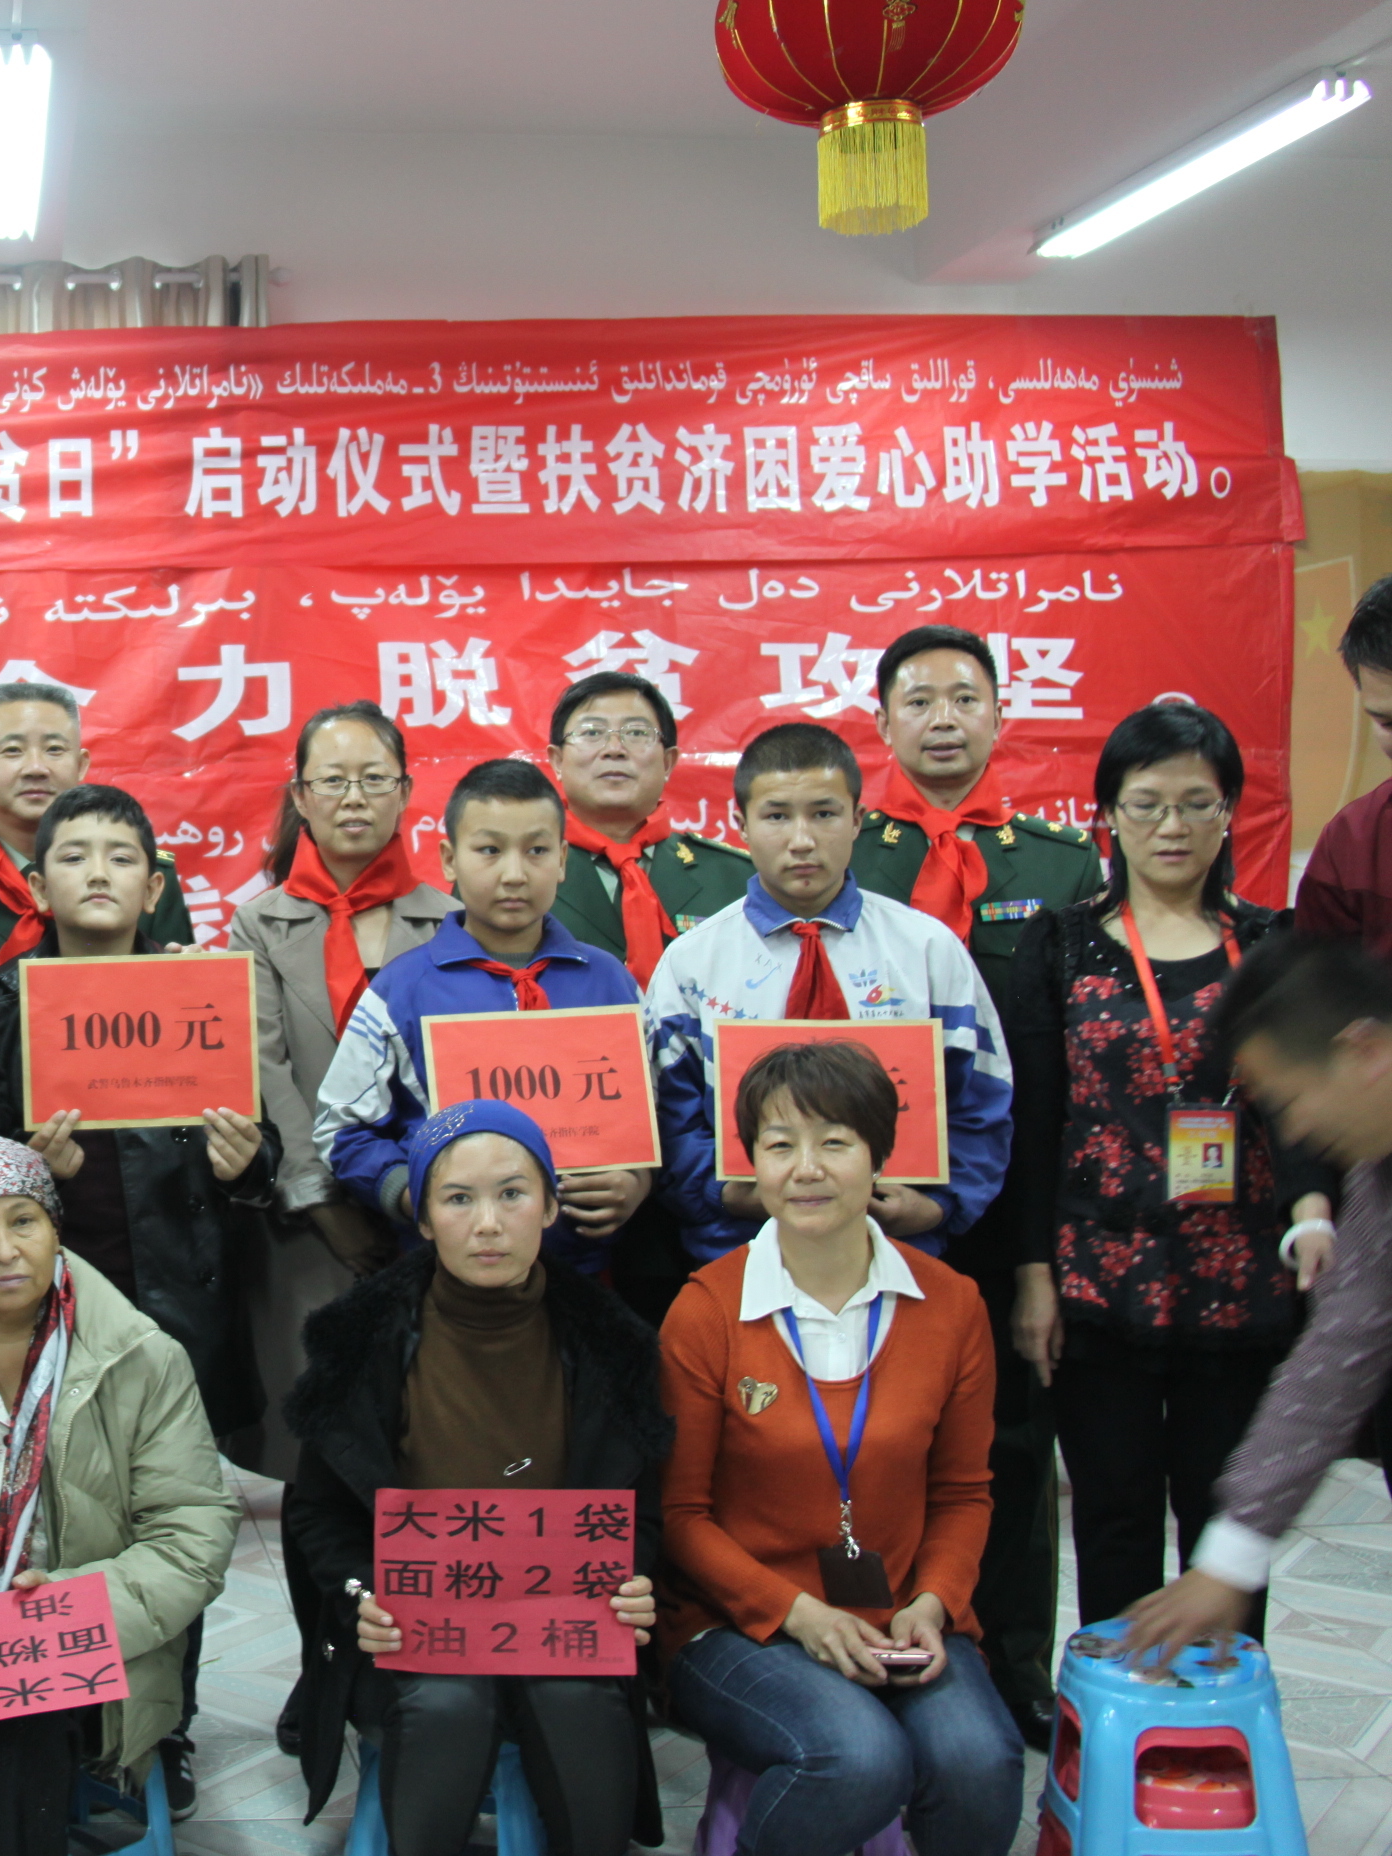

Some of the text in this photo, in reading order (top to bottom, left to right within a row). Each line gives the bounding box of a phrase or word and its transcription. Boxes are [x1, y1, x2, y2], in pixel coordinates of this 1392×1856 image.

[60, 1003, 225, 1051] 1000 元
[465, 1055, 622, 1103] 1000 元
